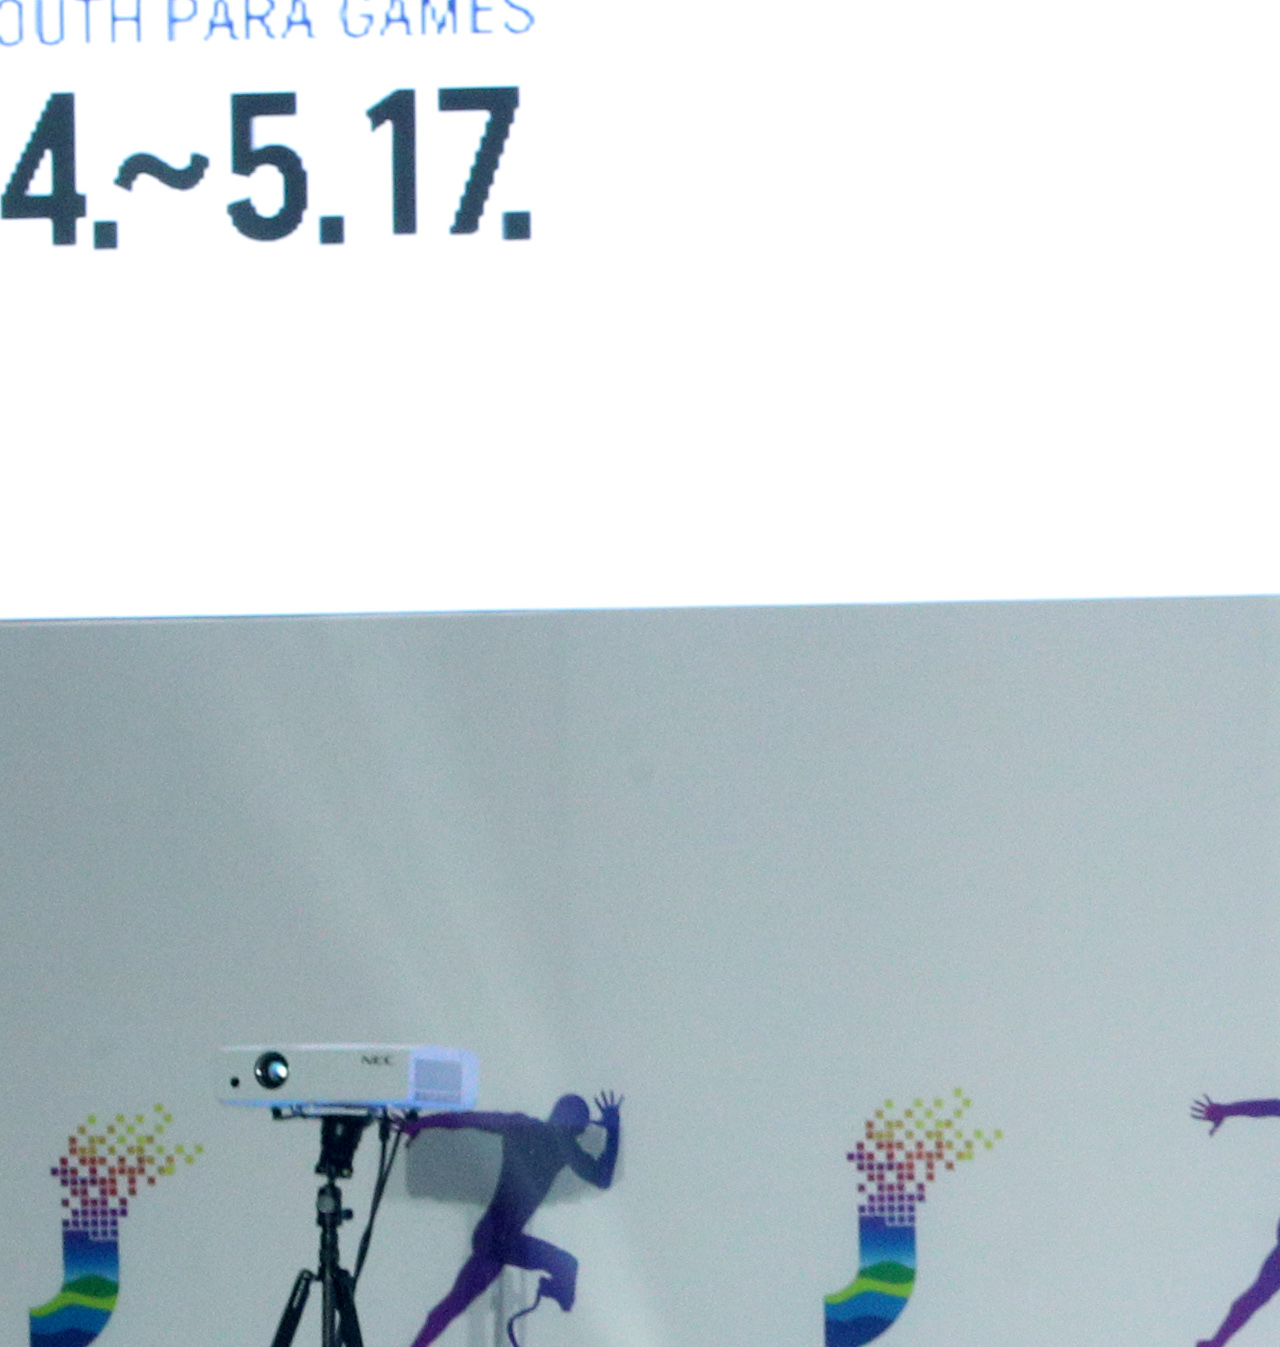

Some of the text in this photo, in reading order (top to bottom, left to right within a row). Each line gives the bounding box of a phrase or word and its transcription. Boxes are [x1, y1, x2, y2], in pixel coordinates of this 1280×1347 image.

[166, 0, 316, 42] PARA
[338, 0, 535, 38] GAMES
[361, 1054, 394, 1066] NEC
